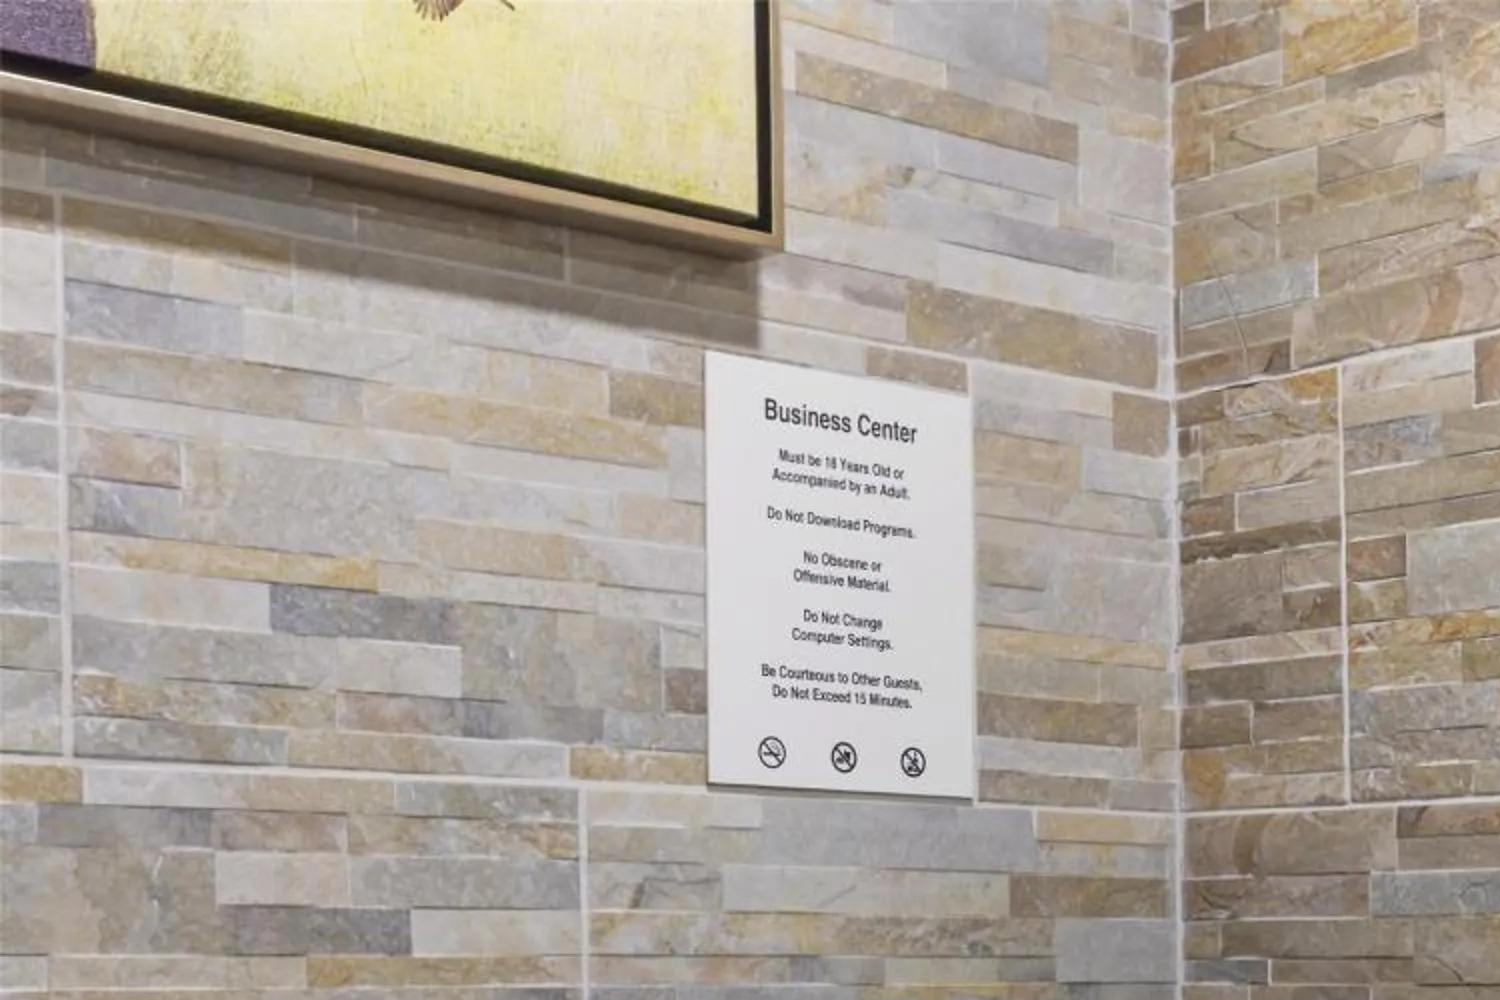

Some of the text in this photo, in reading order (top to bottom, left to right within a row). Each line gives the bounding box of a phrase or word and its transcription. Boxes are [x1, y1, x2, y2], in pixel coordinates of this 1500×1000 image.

[764, 398, 918, 444] Business Center
[779, 448, 905, 480] Must be 18 Years Old or
[772, 467, 911, 500] Accompanied by an Adult.
[767, 506, 917, 539] Do Not Download Programs.
[803, 550, 882, 573] No Obscene or
[793, 568, 892, 593] Offensive Material.
[803, 609, 883, 632] Do Not Change
[792, 627, 894, 652] Computer Settings.
[761, 663, 777, 678] Be
[779, 665, 835, 683] Courteous
[838, 671, 849, 685] to
[851, 672, 881, 687] Other
[772, 684, 912, 709] Do Not Exceed 15 Minutes.
